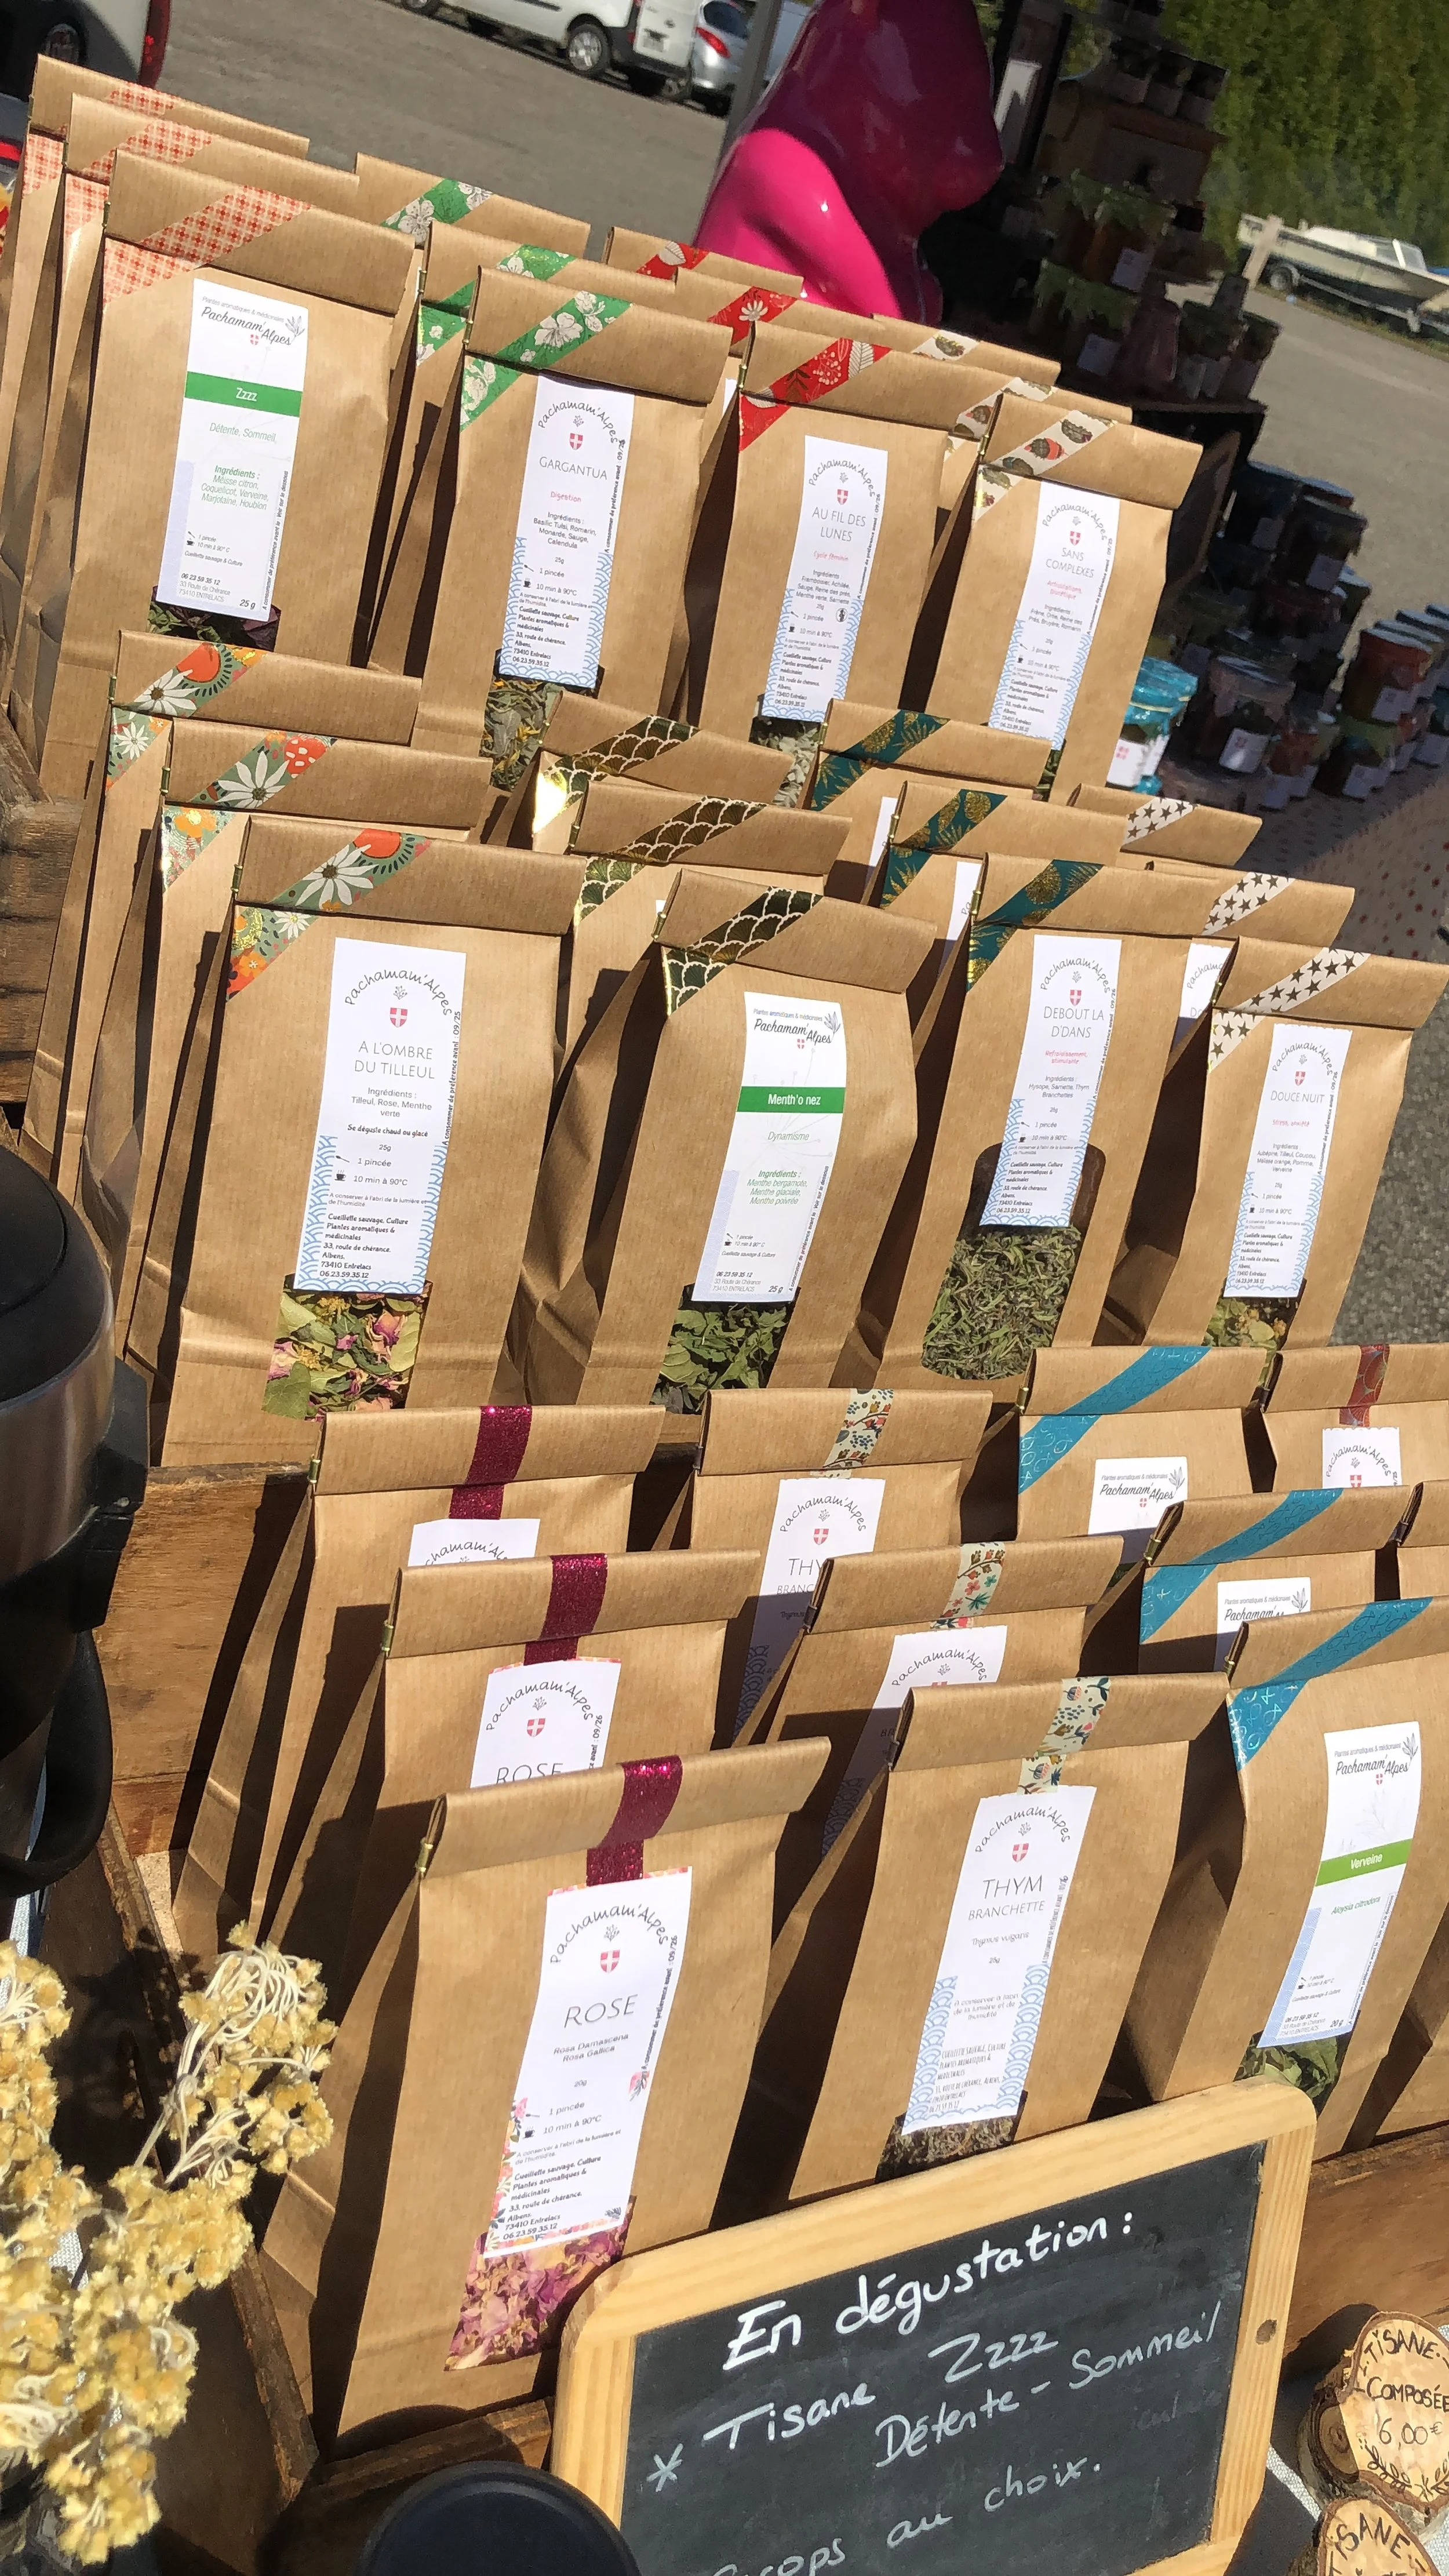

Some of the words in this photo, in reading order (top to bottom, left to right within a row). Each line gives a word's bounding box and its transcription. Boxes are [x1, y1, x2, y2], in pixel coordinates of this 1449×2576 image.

[235, 387, 257, 402] Zzzz
[538, 401, 618, 443] Pachamam'Alpes
[214, 465, 256, 479] Ingrédients
[539, 456, 607, 481] GARGANTUA
[550, 491, 581, 503] Digestion
[811, 506, 829, 520] AU
[831, 510, 844, 523] FIL
[847, 514, 867, 527] DES
[547, 537, 578, 549] Calendula
[820, 526, 853, 542] LUNES
[1061, 547, 1084, 562] SANS
[1046, 558, 1095, 578] COMPLEXES
[239, 599, 250, 607] 25
[1040, 958, 1111, 994] Pachamam'Alpes
[344, 969, 452, 1016] Pachamam'Alpes
[452, 1010, 461, 1035] 09/25
[1043, 1006, 1090, 1020] DEBOUT
[1092, 1009, 1104, 1021] LA
[753, 1018, 832, 1046] Pachamam'Alpes
[1051, 1025, 1091, 1038] D'DANS
[358, 1040, 369, 1053] A
[373, 1042, 433, 1060] L'OMBRE
[450, 1041, 459, 1058] avant
[354, 1060, 376, 1073] DU
[380, 1062, 435, 1079] TILLEUL
[447, 1060, 457, 1093] préférence
[367, 1087, 413, 1098] Ingrédients
[768, 1093, 804, 1105] Menth'o
[805, 1096, 821, 1105] nez
[1270, 1090, 1301, 1102] DOUCE
[1302, 1093, 1325, 1103] NUIT
[351, 1096, 376, 1106] Tilleul,
[377, 1098, 399, 1108] Rose,
[402, 1101, 432, 1111] Menthe
[444, 1104, 453, 1139] consommer
[357, 1125, 381, 1135] déguste
[382, 1127, 402, 1135] chaud
[412, 1130, 428, 1138] glacé
[767, 1131, 810, 1142] Dynamisme
[378, 1144, 391, 1152] 25g
[747, 1178, 772, 1187] Menthe
[772, 1179, 808, 1188] bergamote,
[758, 1170, 798, 1179] Ingrédients
[749, 1196, 775, 1205] Menthe
[774, 1197, 799, 1206] poivrée
[750, 1188, 775, 1196] Menthe
[325, 1232, 361, 1241] médicinales
[326, 1222, 349, 1231] Plantes
[351, 1226, 389, 1234] aromatiques
[1100, 1482, 1174, 1503] Pachamam'Alpes
[780, 1495, 866, 1533] Pachamam'Alpes
[891, 1649, 987, 1686] Pachamam'Alpes
[486, 1680, 594, 1731] Pachamam'Alpes
[1335, 1754, 1408, 1778] Pachamam'Alpes
[975, 1806, 1071, 1853] Pachamam'Alpes
[1350, 1854, 1383, 1869] Verveine
[982, 1875, 1042, 1899] THYM
[968, 1900, 1045, 1921] BRANCHETTE
[550, 1904, 668, 1963] Pachamam'Alpes
[564, 1994, 638, 2028] ROSE
[554, 2046, 575, 2055] Rosa
[577, 2034, 629, 2050] Damascena
[563, 2053, 584, 2062] Rosa
[587, 2046, 615, 2057] Gallica
[556, 2102, 585, 2116] pincée
[721, 2300, 803, 2371] En
[702, 2381, 877, 2450] Tisane
[928, 2327, 1059, 2384] Zzzz
[875, 2389, 1020, 2469] Détente
[1069, 2300, 1222, 2391] Sommeil
[886, 2511, 953, 2548] au
[984, 2457, 1101, 2513] choix.
